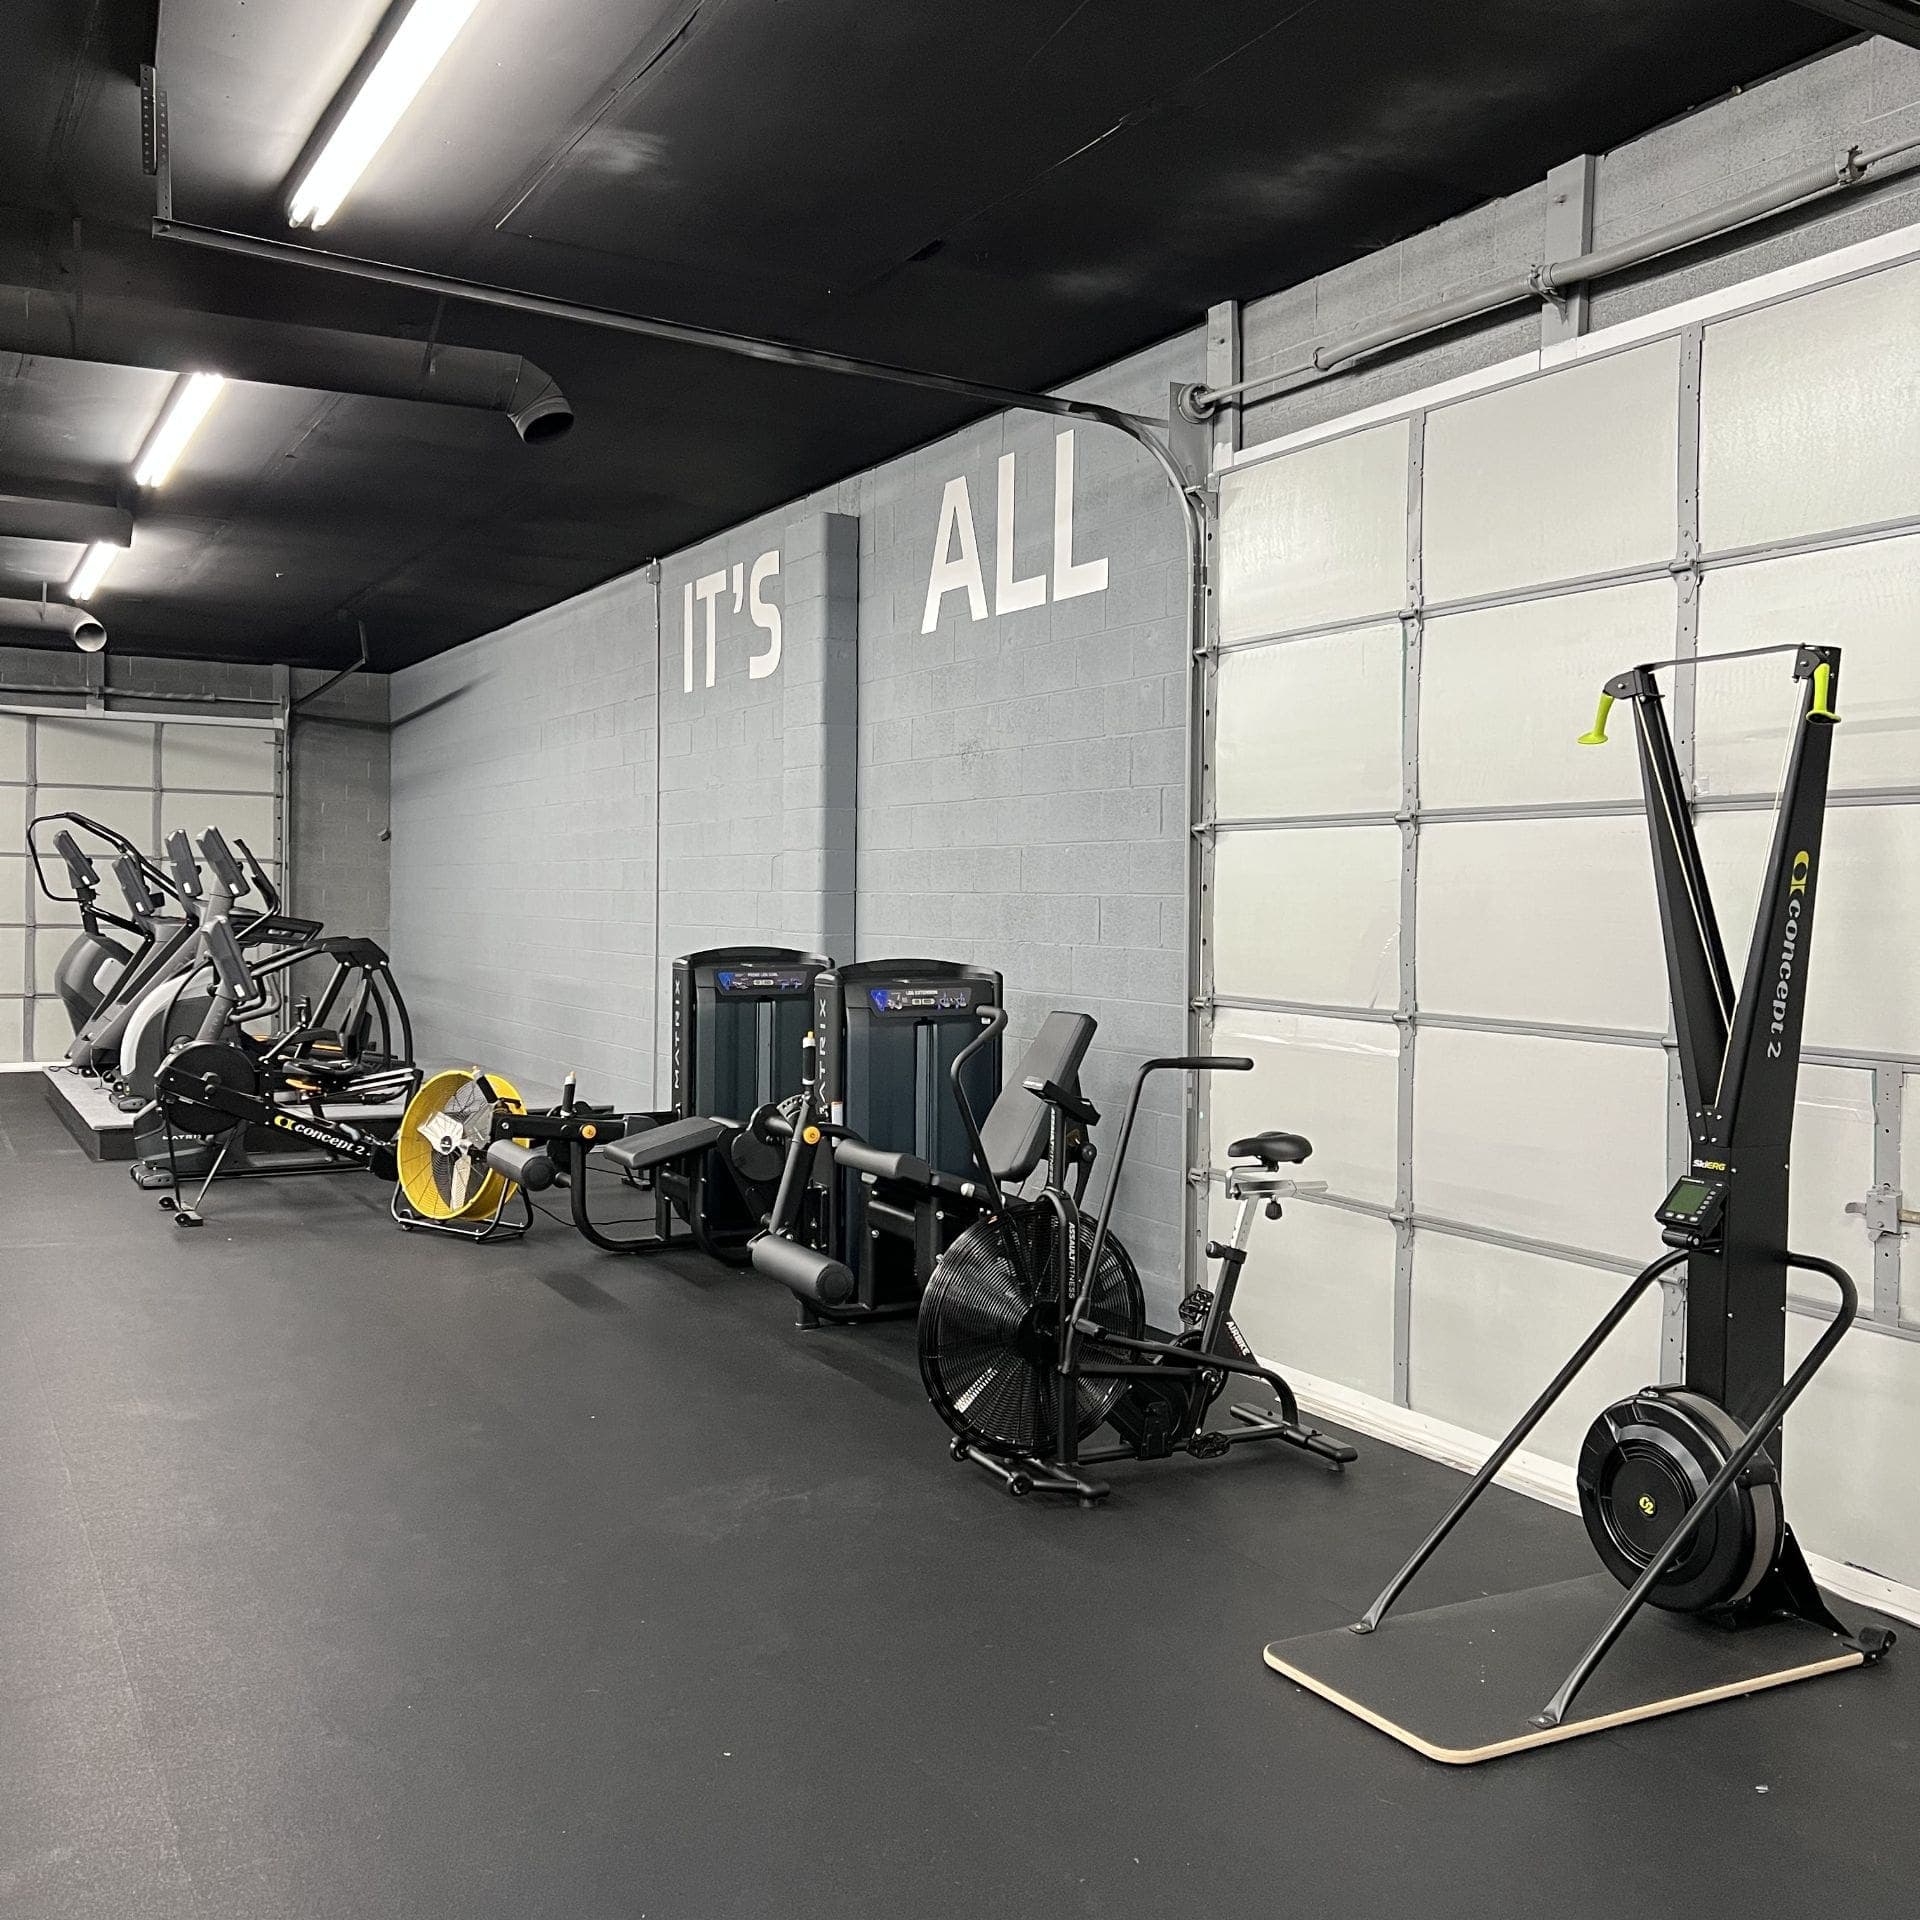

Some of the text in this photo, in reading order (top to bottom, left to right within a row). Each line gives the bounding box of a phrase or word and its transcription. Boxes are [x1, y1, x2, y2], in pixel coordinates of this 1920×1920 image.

[683, 429, 1109, 693] IT'S ALL
[1767, 899, 1800, 1058] concept 2
[294, 1124, 365, 1155] concept 2
[1225, 1321, 1251, 1356] AIRBIKE
[1639, 1496, 1654, 1515] C2
